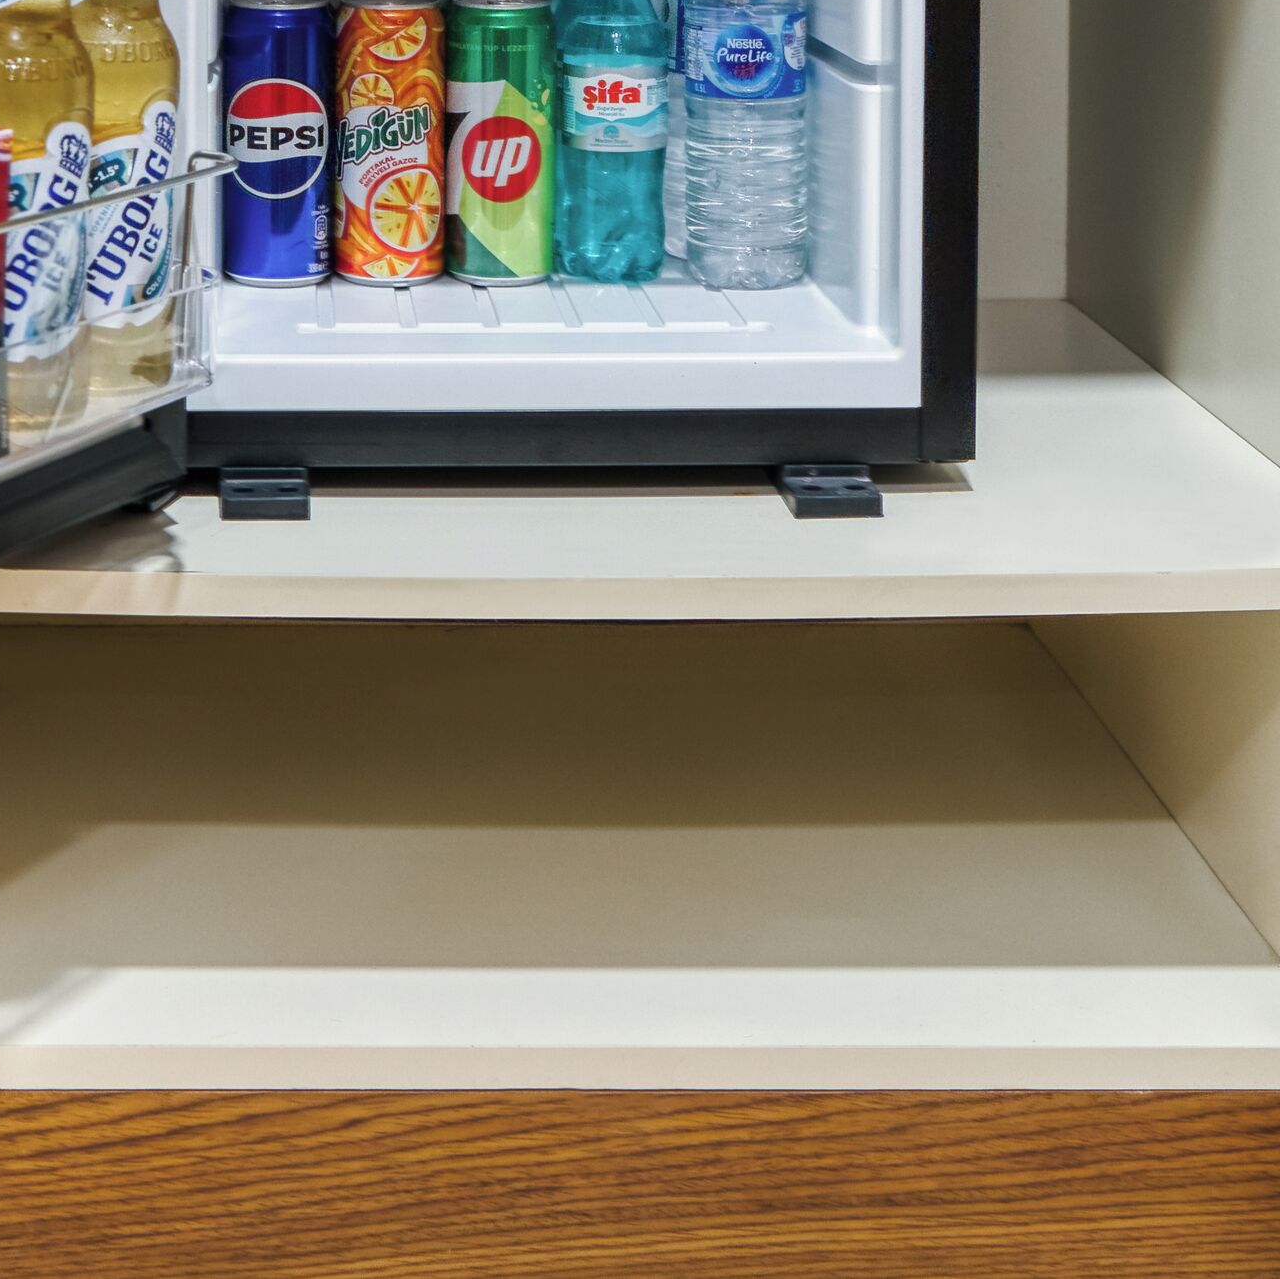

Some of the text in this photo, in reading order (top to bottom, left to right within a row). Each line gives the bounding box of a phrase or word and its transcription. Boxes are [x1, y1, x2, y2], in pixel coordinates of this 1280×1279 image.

[230, 124, 324, 150] PEPSI
[358, 155, 397, 185] PORTAKAL
[392, 156, 419, 167] GAZOZ
[138, 222, 163, 264] ICE
[41, 250, 70, 293] ICE
